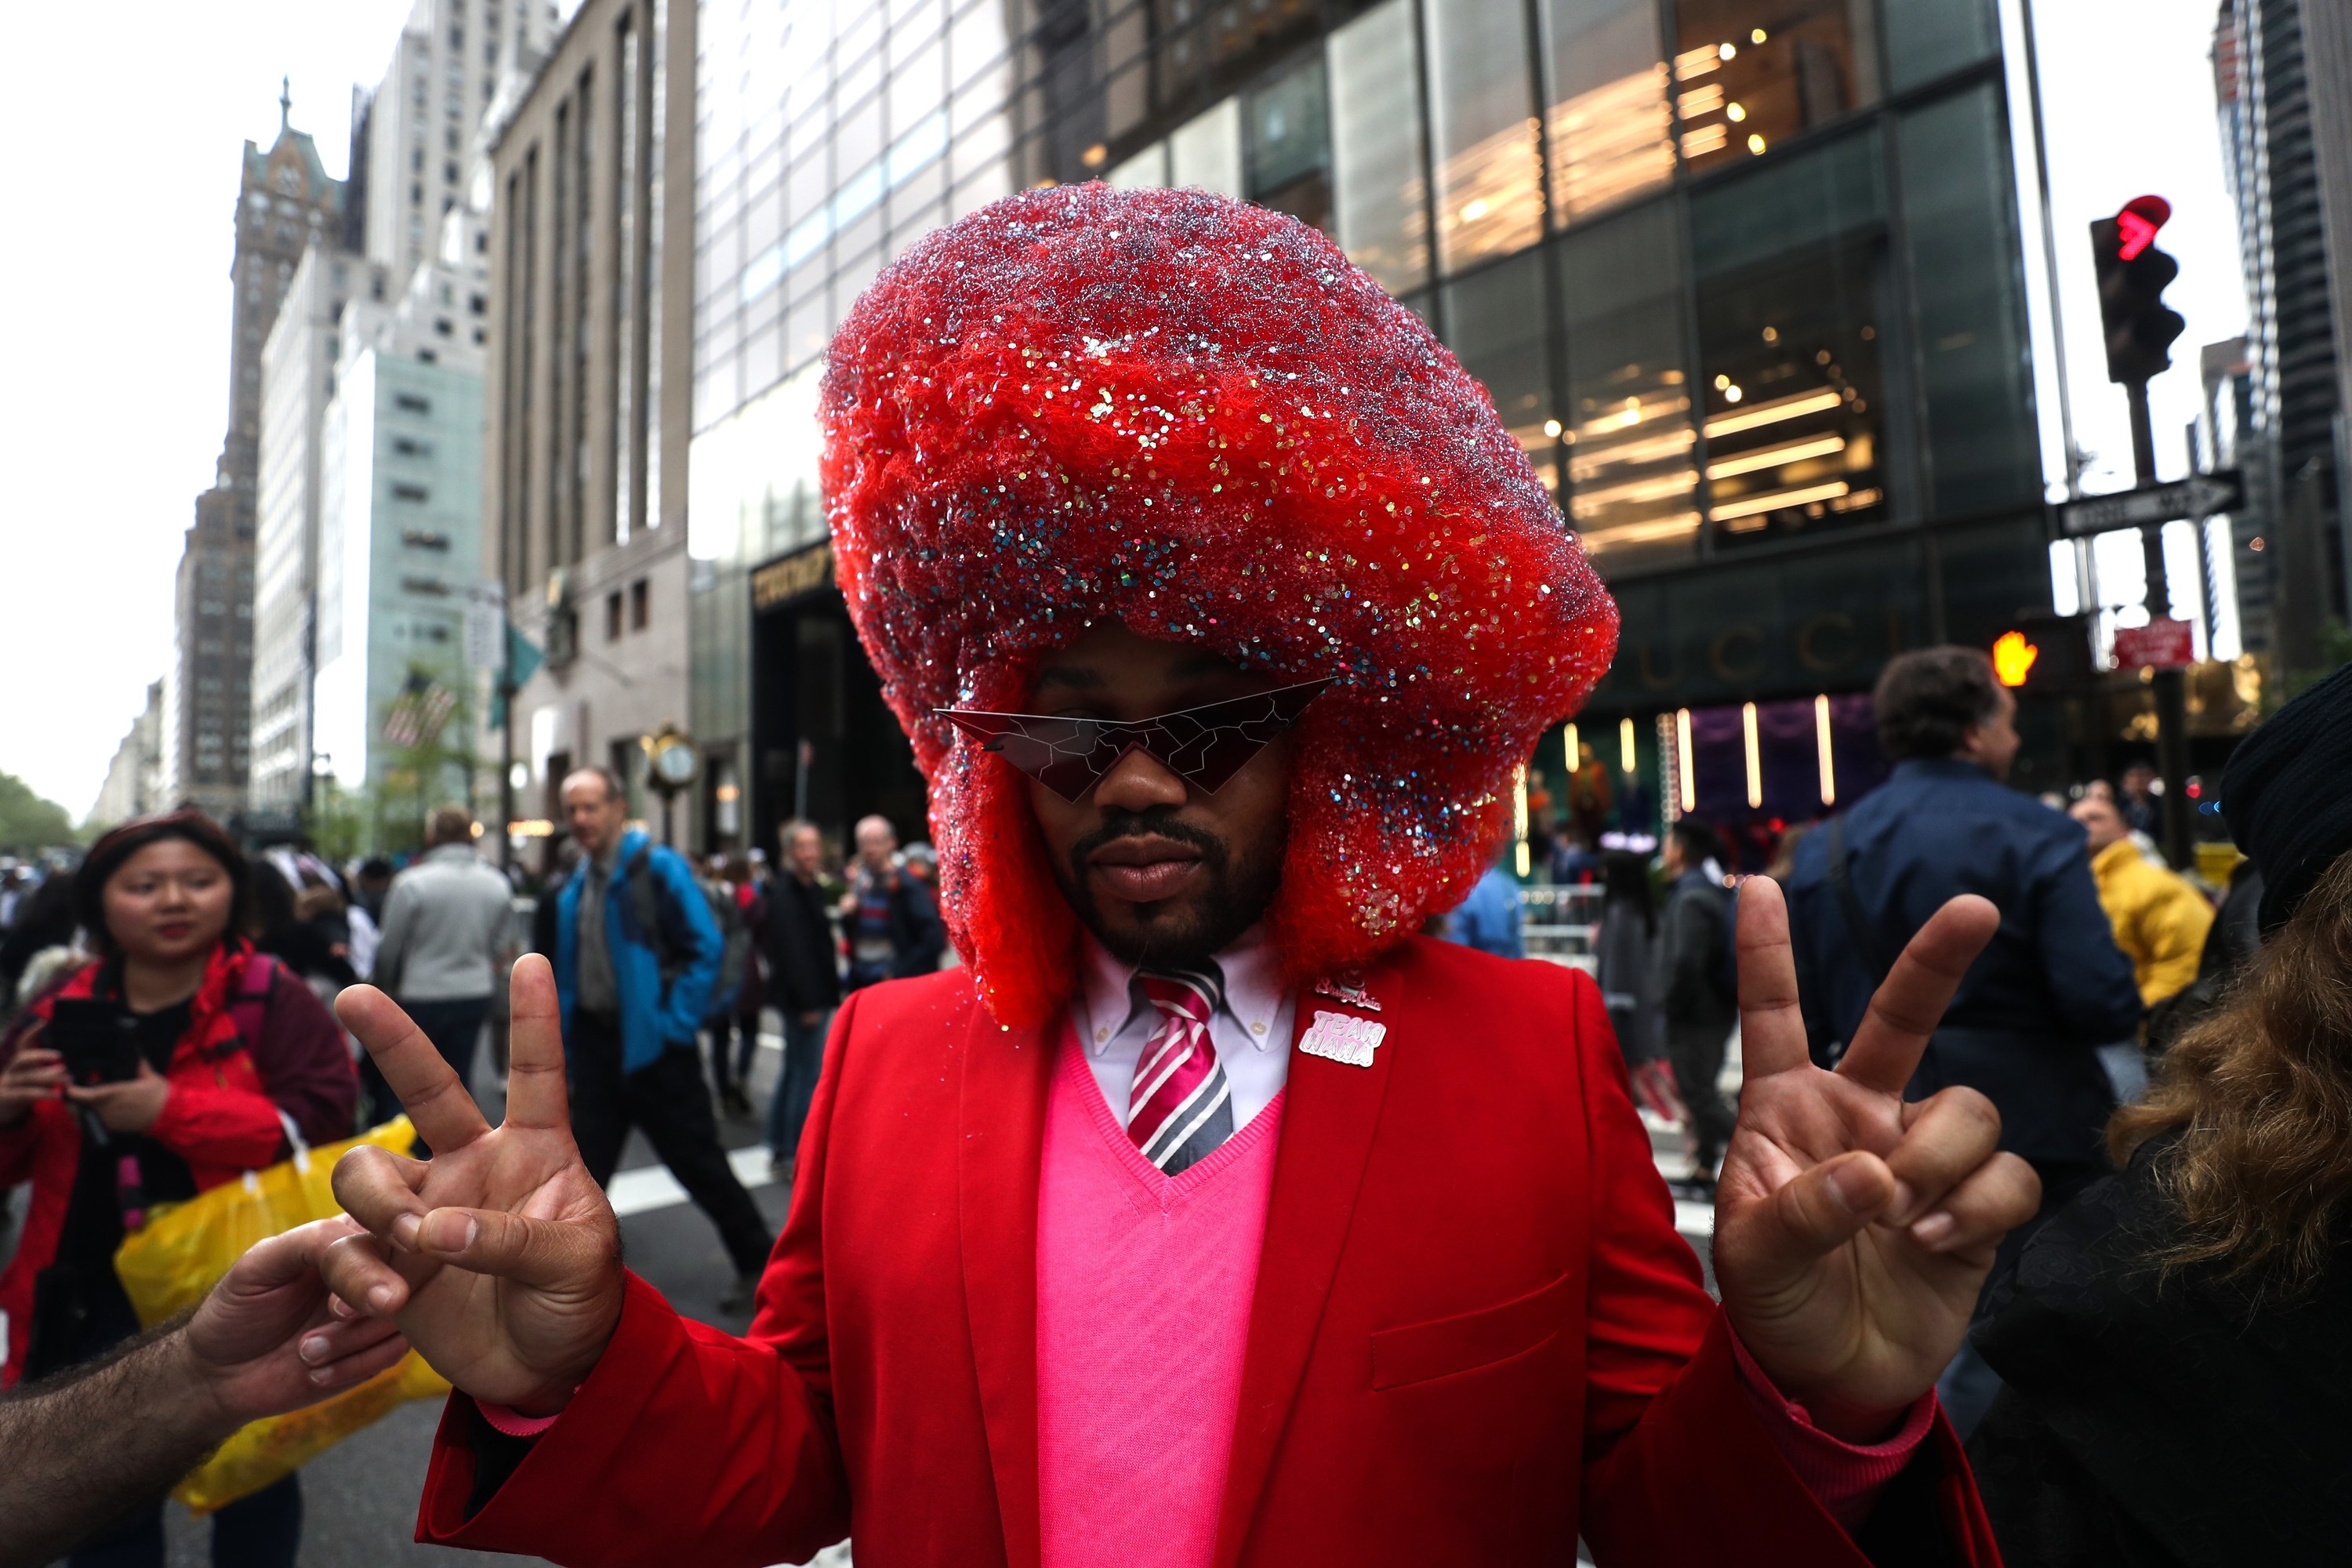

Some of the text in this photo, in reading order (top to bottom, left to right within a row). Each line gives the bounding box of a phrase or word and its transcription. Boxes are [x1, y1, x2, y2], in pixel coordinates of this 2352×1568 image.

[1601, 608, 1902, 691] UCCI
[1314, 1012, 1385, 1046] TEAM
[1303, 1030, 1371, 1065] NANA
